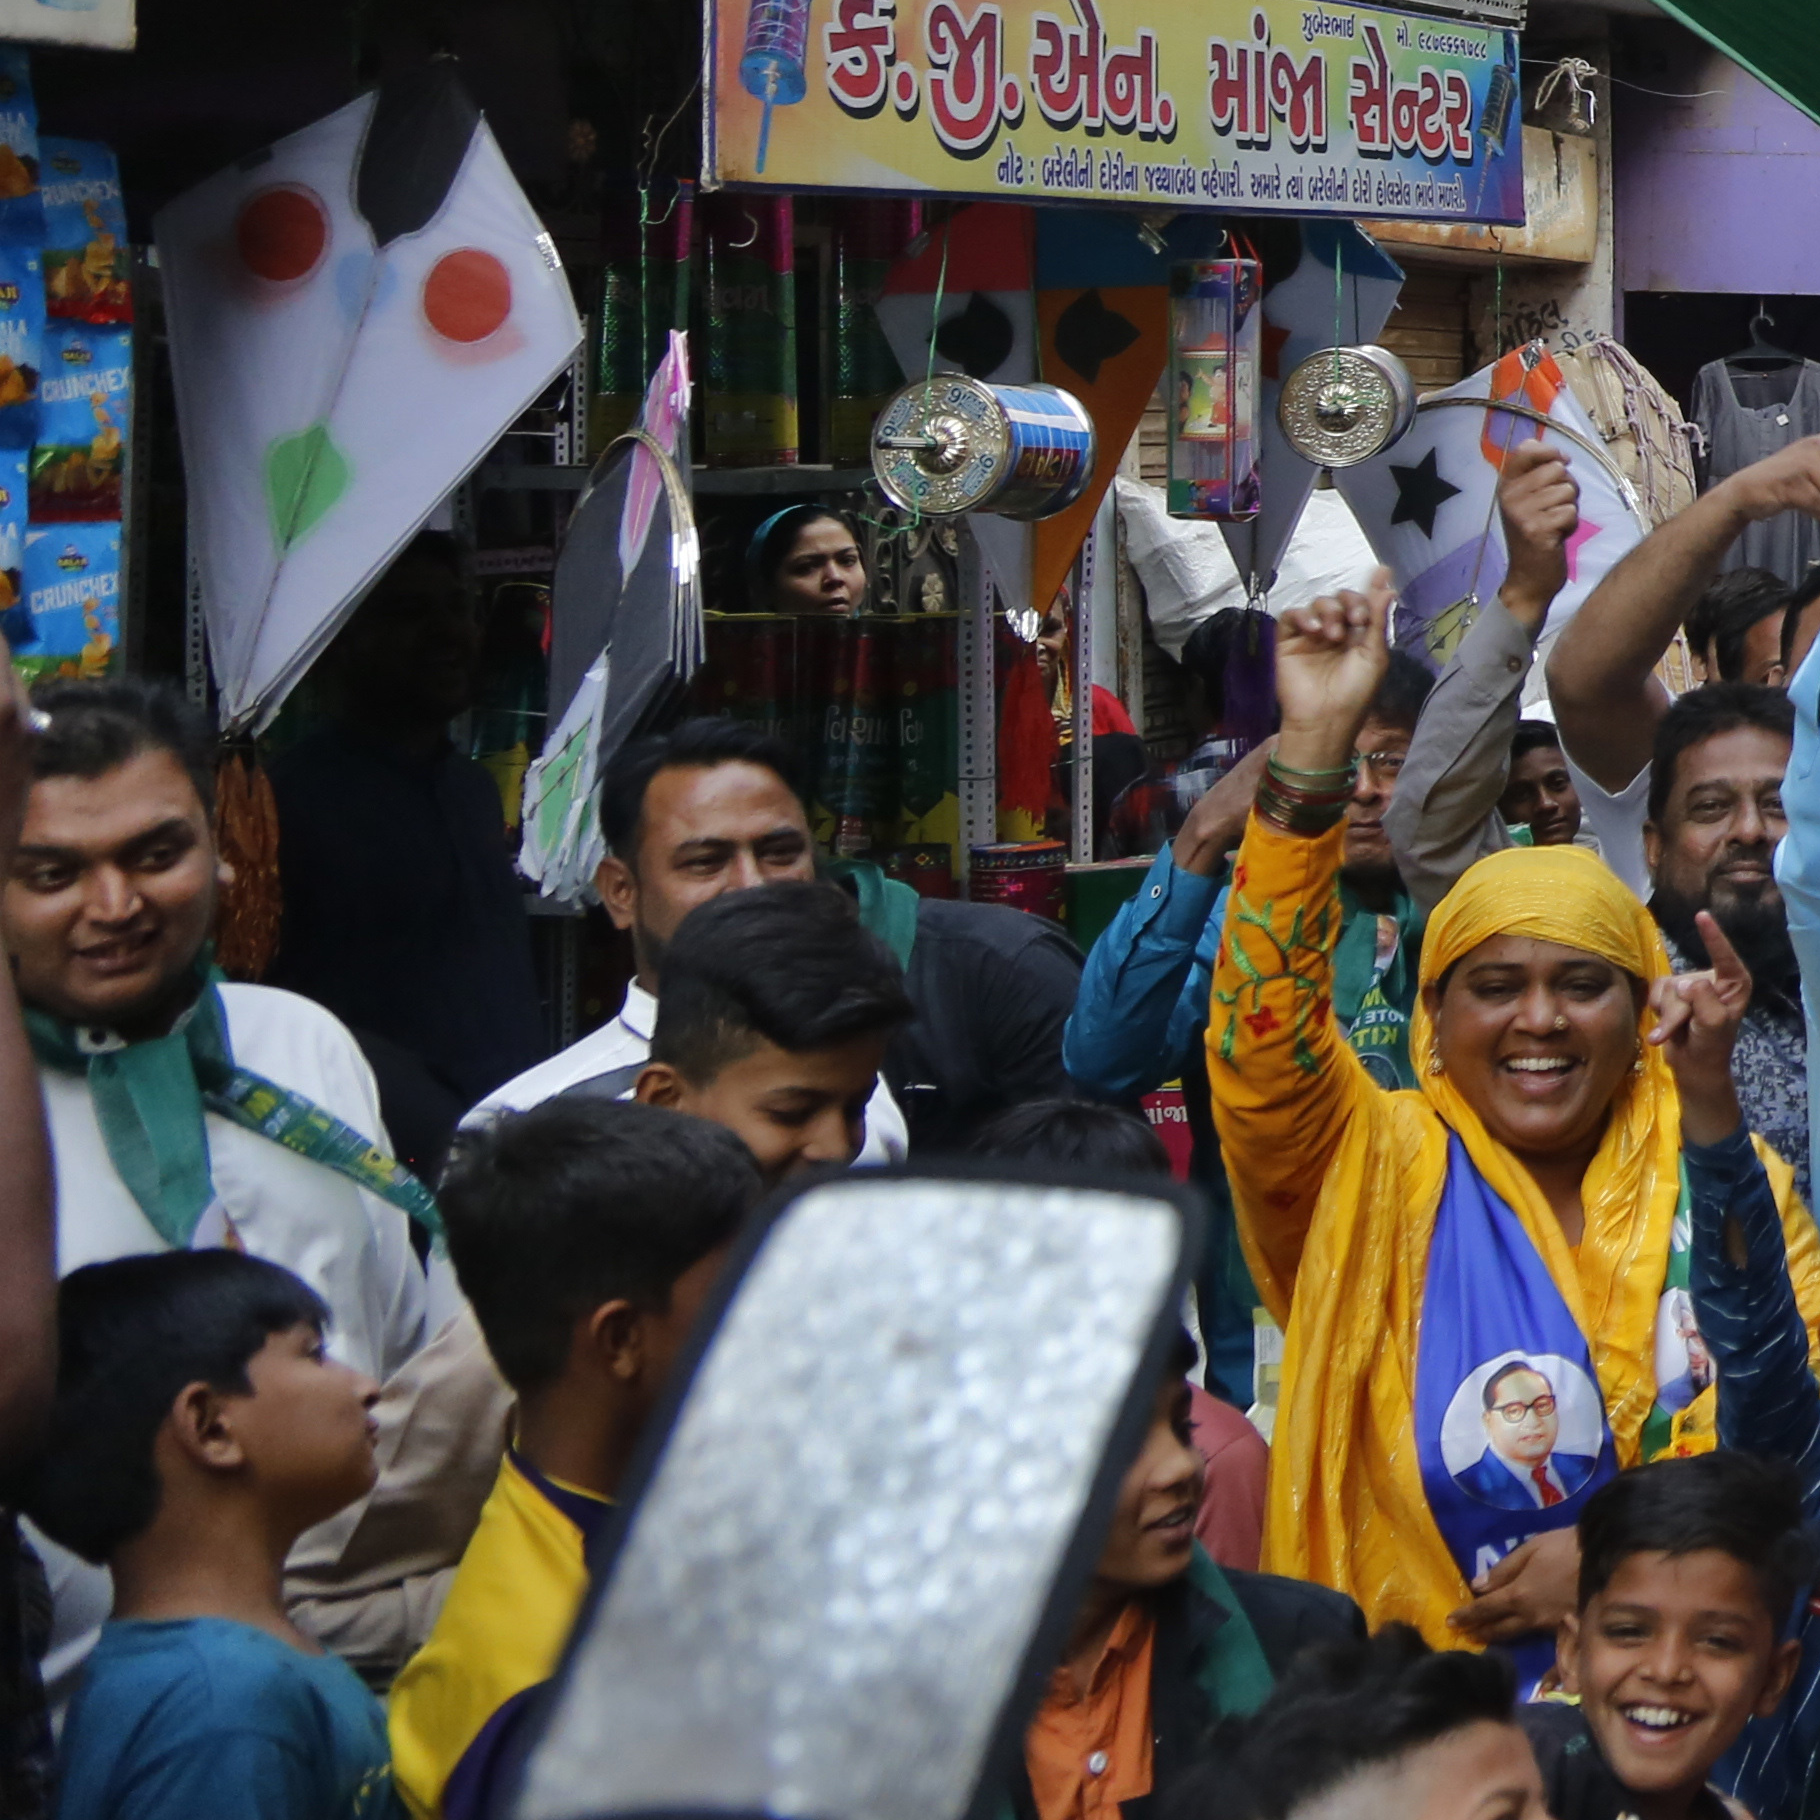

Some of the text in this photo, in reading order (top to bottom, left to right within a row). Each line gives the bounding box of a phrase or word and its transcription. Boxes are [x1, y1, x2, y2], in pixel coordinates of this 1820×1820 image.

[1396, 20, 1412, 48] મો.
[1209, 7, 1327, 151] માંજા
[1350, 21, 1473, 165] સેન્ટર
[1042, 145, 1094, 189] બરેલીની
[1099, 149, 1138, 192] દોરીના
[1250, 163, 1280, 200] અમારે
[1286, 167, 1303, 200] ત્યાં
[1308, 166, 1348, 203] બરેલીની
[1352, 168, 1372, 204] દોરી
[1375, 168, 1411, 207] હોલસેલ
[1415, 171, 1434, 208] ભાવે
[41, 366, 130, 403] CRUNCHEX
[30, 572, 120, 616] CRUNCHEX
